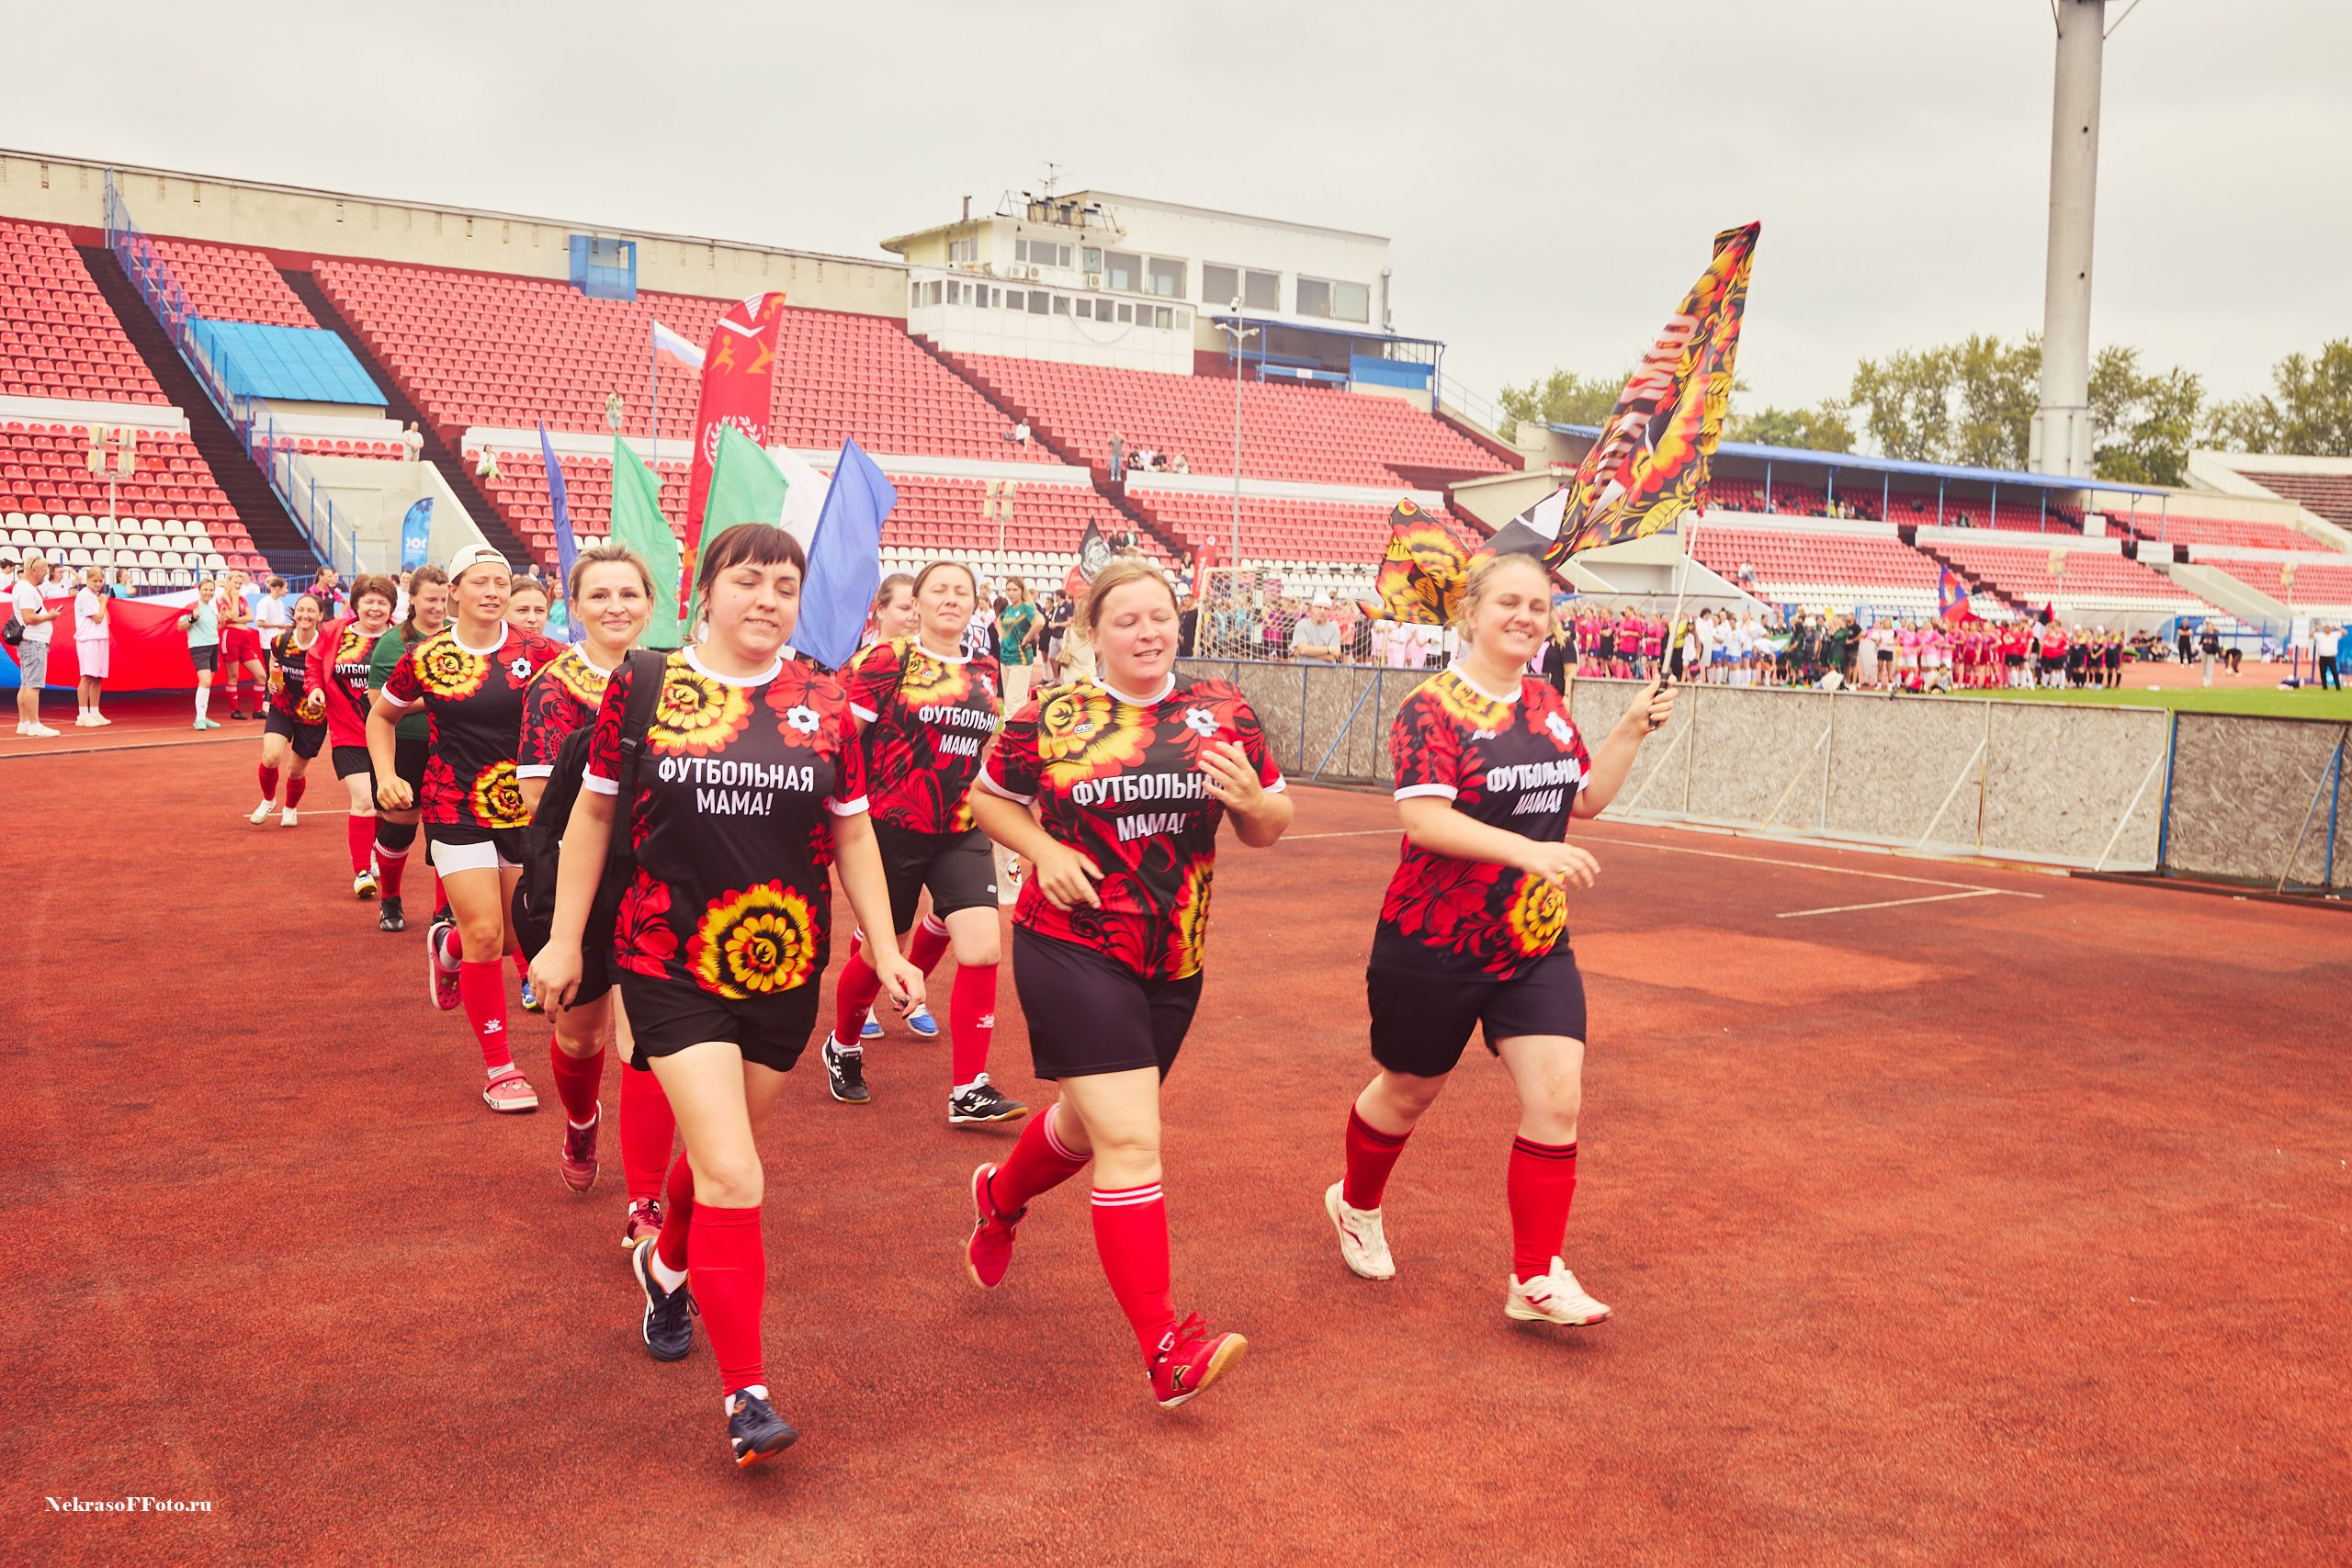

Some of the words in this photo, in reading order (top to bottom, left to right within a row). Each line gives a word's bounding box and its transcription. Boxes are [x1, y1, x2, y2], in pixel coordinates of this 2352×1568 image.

[658, 757, 814, 793] ФУТБОЛЬНАЯ
[1071, 773, 1227, 807] ФУТБОЛЬНА
[695, 788, 774, 816] МАМА!
[1511, 788, 1564, 816] МАМА!
[1116, 811, 1188, 842] МАМА!
